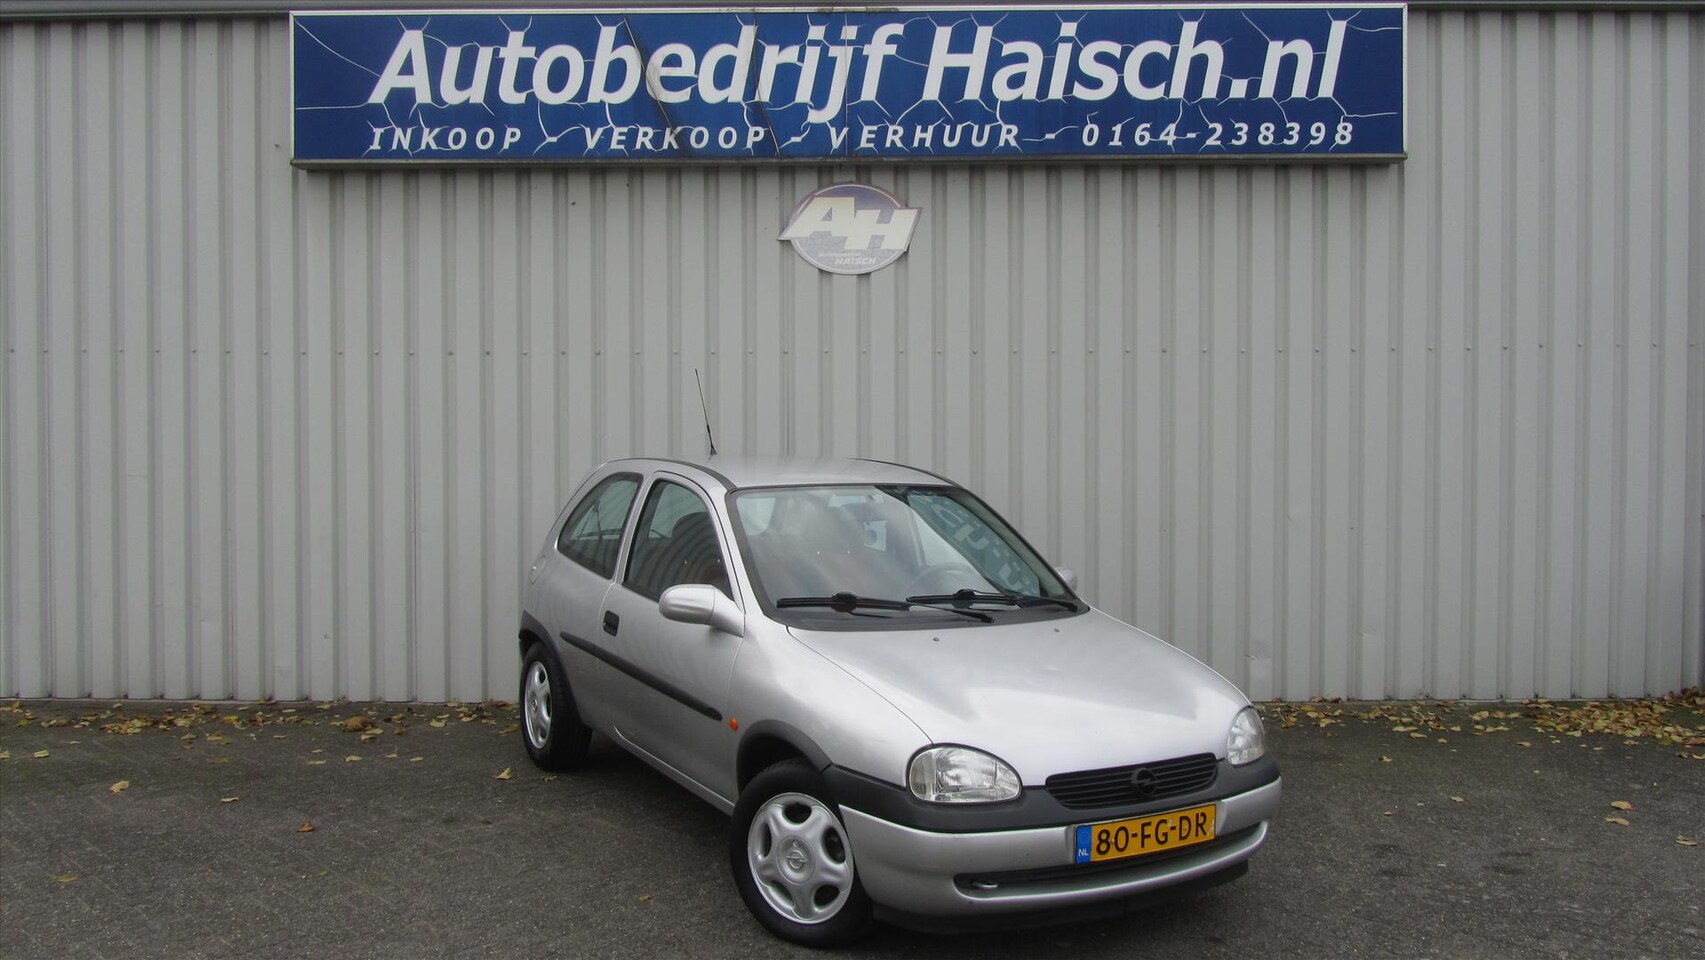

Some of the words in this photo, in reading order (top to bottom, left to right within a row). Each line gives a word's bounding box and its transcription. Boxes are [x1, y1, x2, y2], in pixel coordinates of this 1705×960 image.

[367, 23, 904, 124] Autobedrijf
[922, 20, 1347, 101] Haisch.nl
[369, 128, 522, 150] INKOOP
[584, 127, 766, 150] VERKOOP
[829, 125, 1019, 148] VERHUUR
[1082, 123, 1354, 146] 0164-238398
[778, 197, 918, 250] AH
[1078, 848, 1088, 857] NL
[1096, 812, 1207, 855] 80-FG-DR
